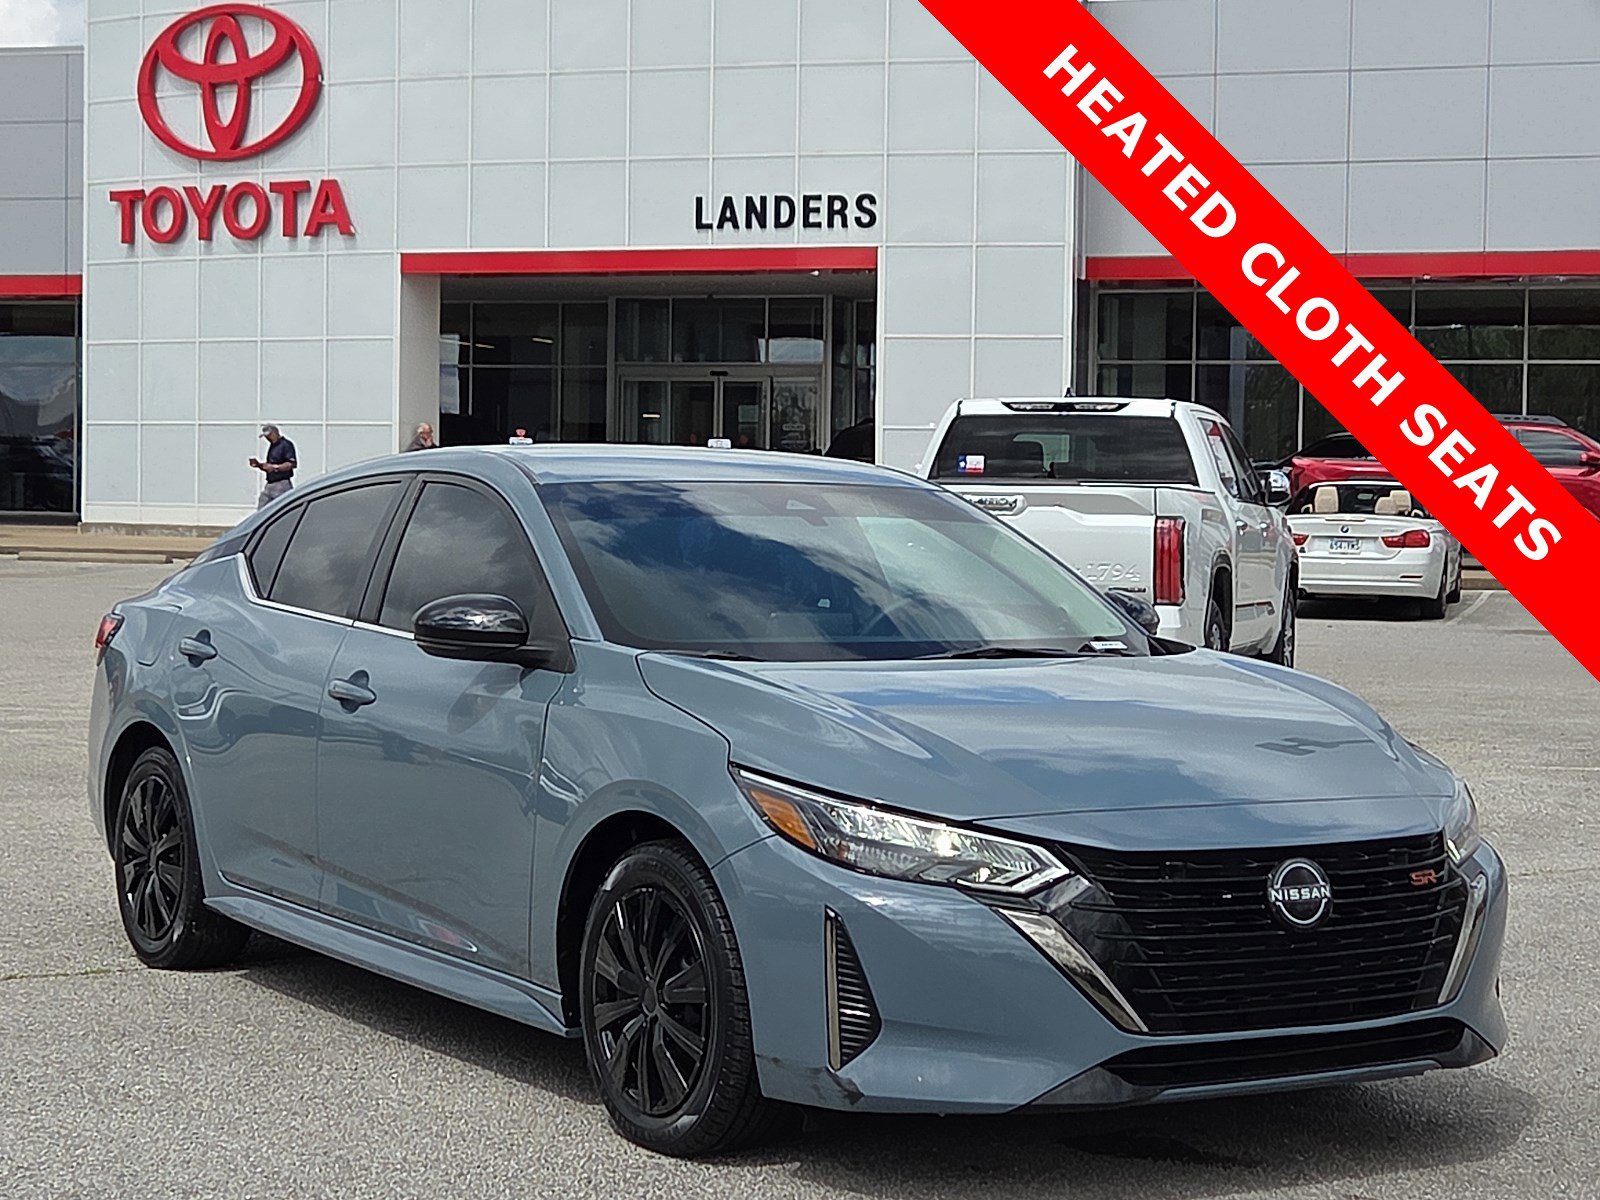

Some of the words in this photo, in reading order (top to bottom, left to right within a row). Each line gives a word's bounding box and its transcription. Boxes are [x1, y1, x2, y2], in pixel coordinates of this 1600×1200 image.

[109, 179, 355, 244] TOYOTA
[695, 193, 877, 230] LANDERS
[1409, 868, 1437, 886] SR
[1270, 885, 1332, 901] NISSAN
